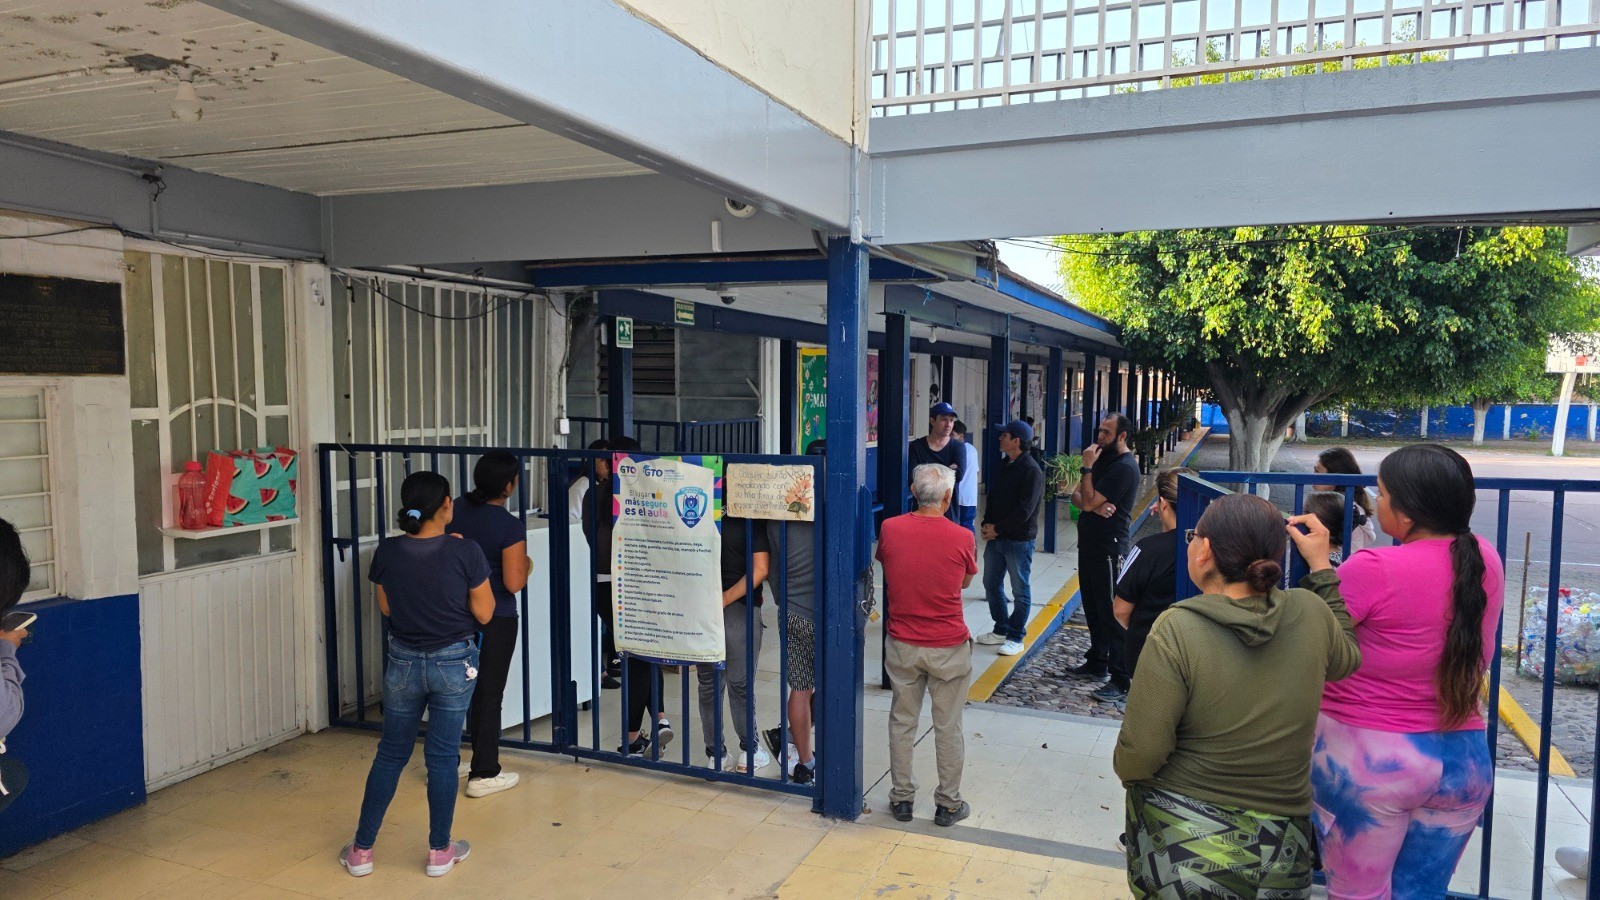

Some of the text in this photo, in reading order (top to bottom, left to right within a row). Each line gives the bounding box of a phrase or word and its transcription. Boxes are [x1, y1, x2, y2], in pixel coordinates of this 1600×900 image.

[814, 394, 827, 407] MA
[620, 465, 637, 474] GTO
[644, 468, 663, 477] GTO
[208, 470, 221, 501] Soriana
[629, 489, 651, 499] El lugar
[625, 497, 668, 509] más seguro
[625, 507, 669, 519] es el aula
